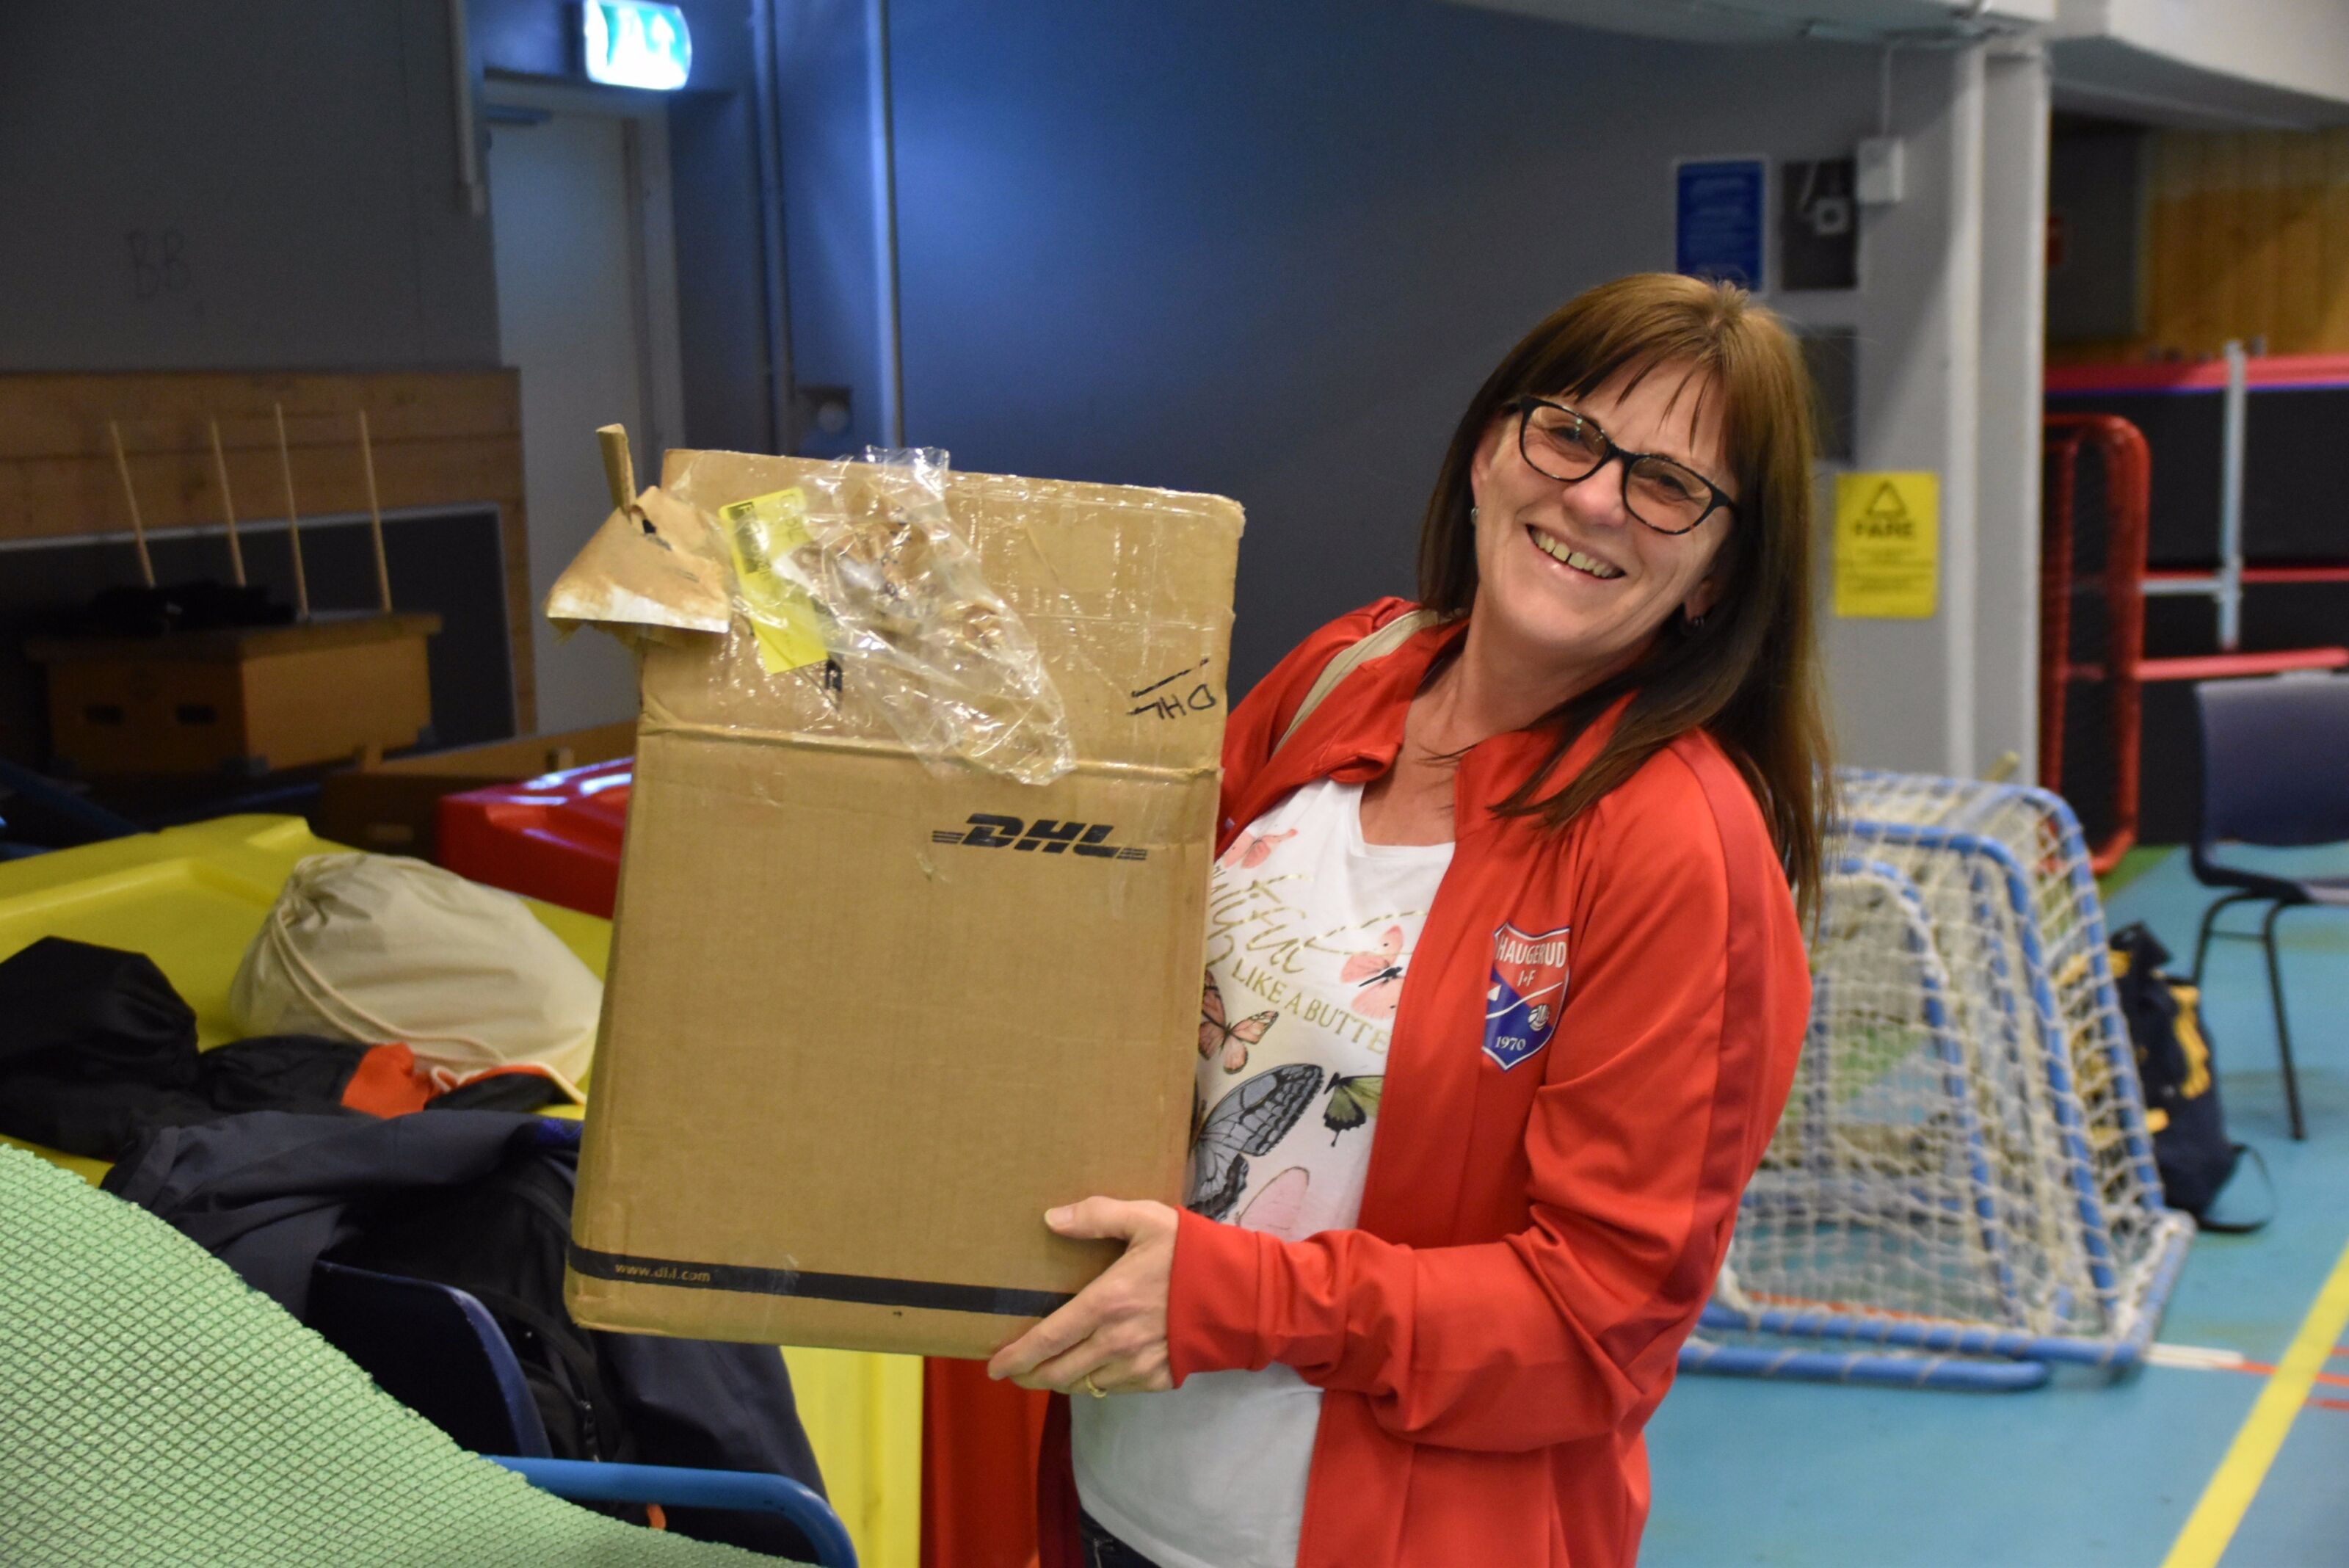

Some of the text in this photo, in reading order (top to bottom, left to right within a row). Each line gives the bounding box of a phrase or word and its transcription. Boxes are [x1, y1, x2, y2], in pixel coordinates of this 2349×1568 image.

[1126, 683, 1216, 720] DHL
[961, 813, 1121, 859] DHL
[1495, 935, 1567, 968] HAUGERUD
[1231, 957, 1288, 1004] LIKE
[1285, 993, 1302, 1015] A
[1495, 1036, 1527, 1051] 1970
